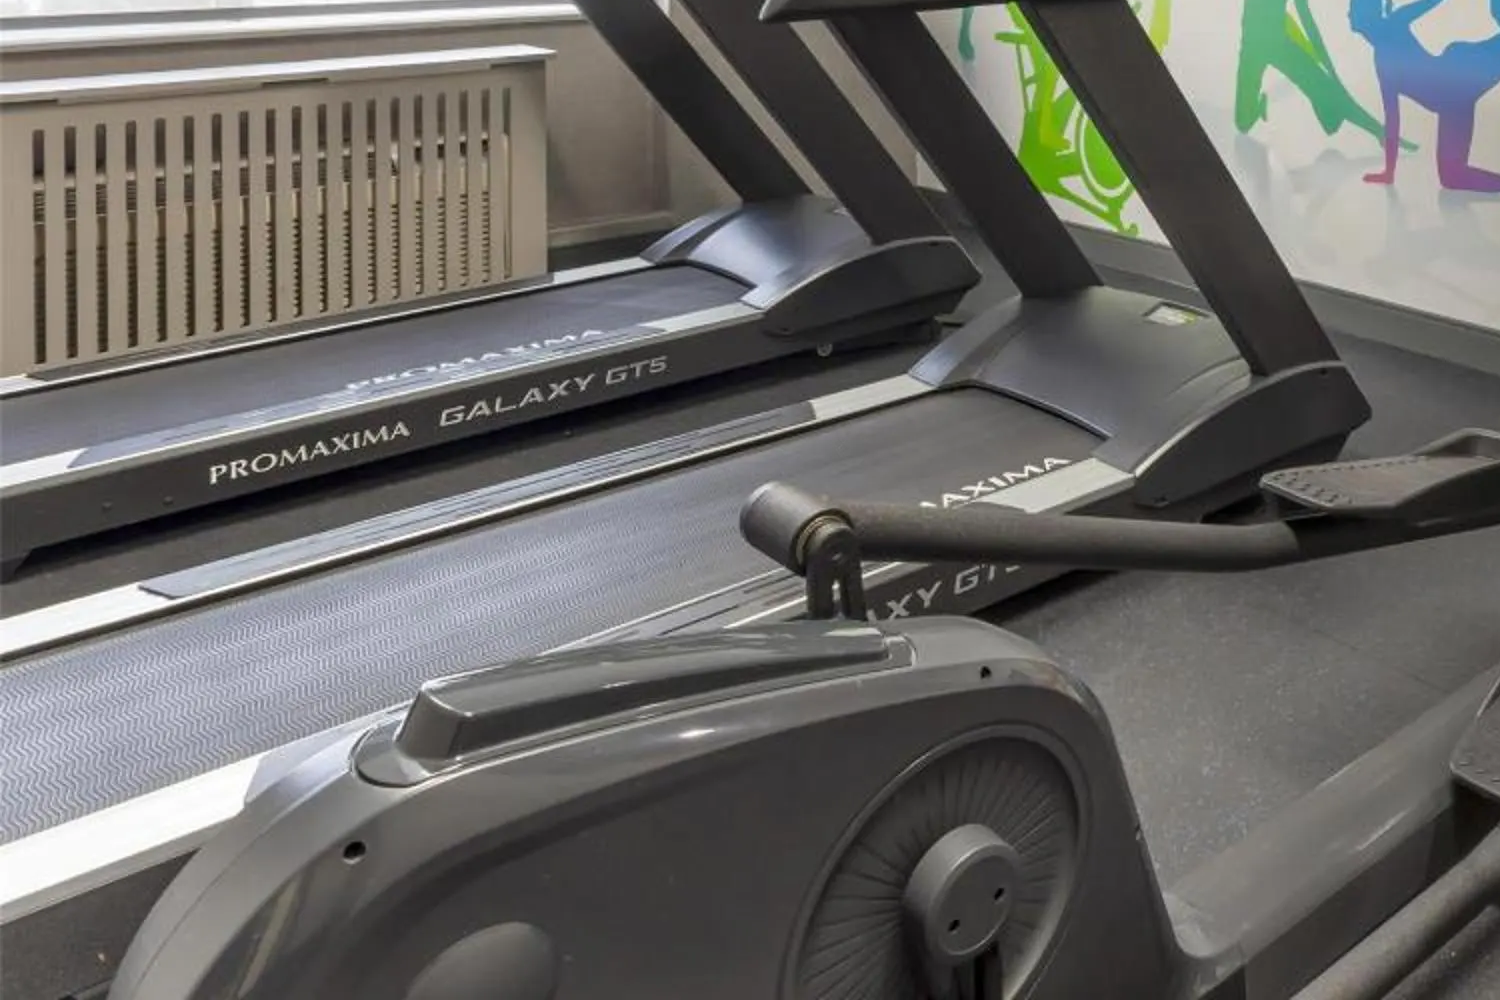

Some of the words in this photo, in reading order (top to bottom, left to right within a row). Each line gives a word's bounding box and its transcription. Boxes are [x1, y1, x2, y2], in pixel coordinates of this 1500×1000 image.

[209, 421, 411, 485] PROMAXIMA
[439, 371, 596, 428] GALAXY
[920, 457, 1072, 508] AXIMA
